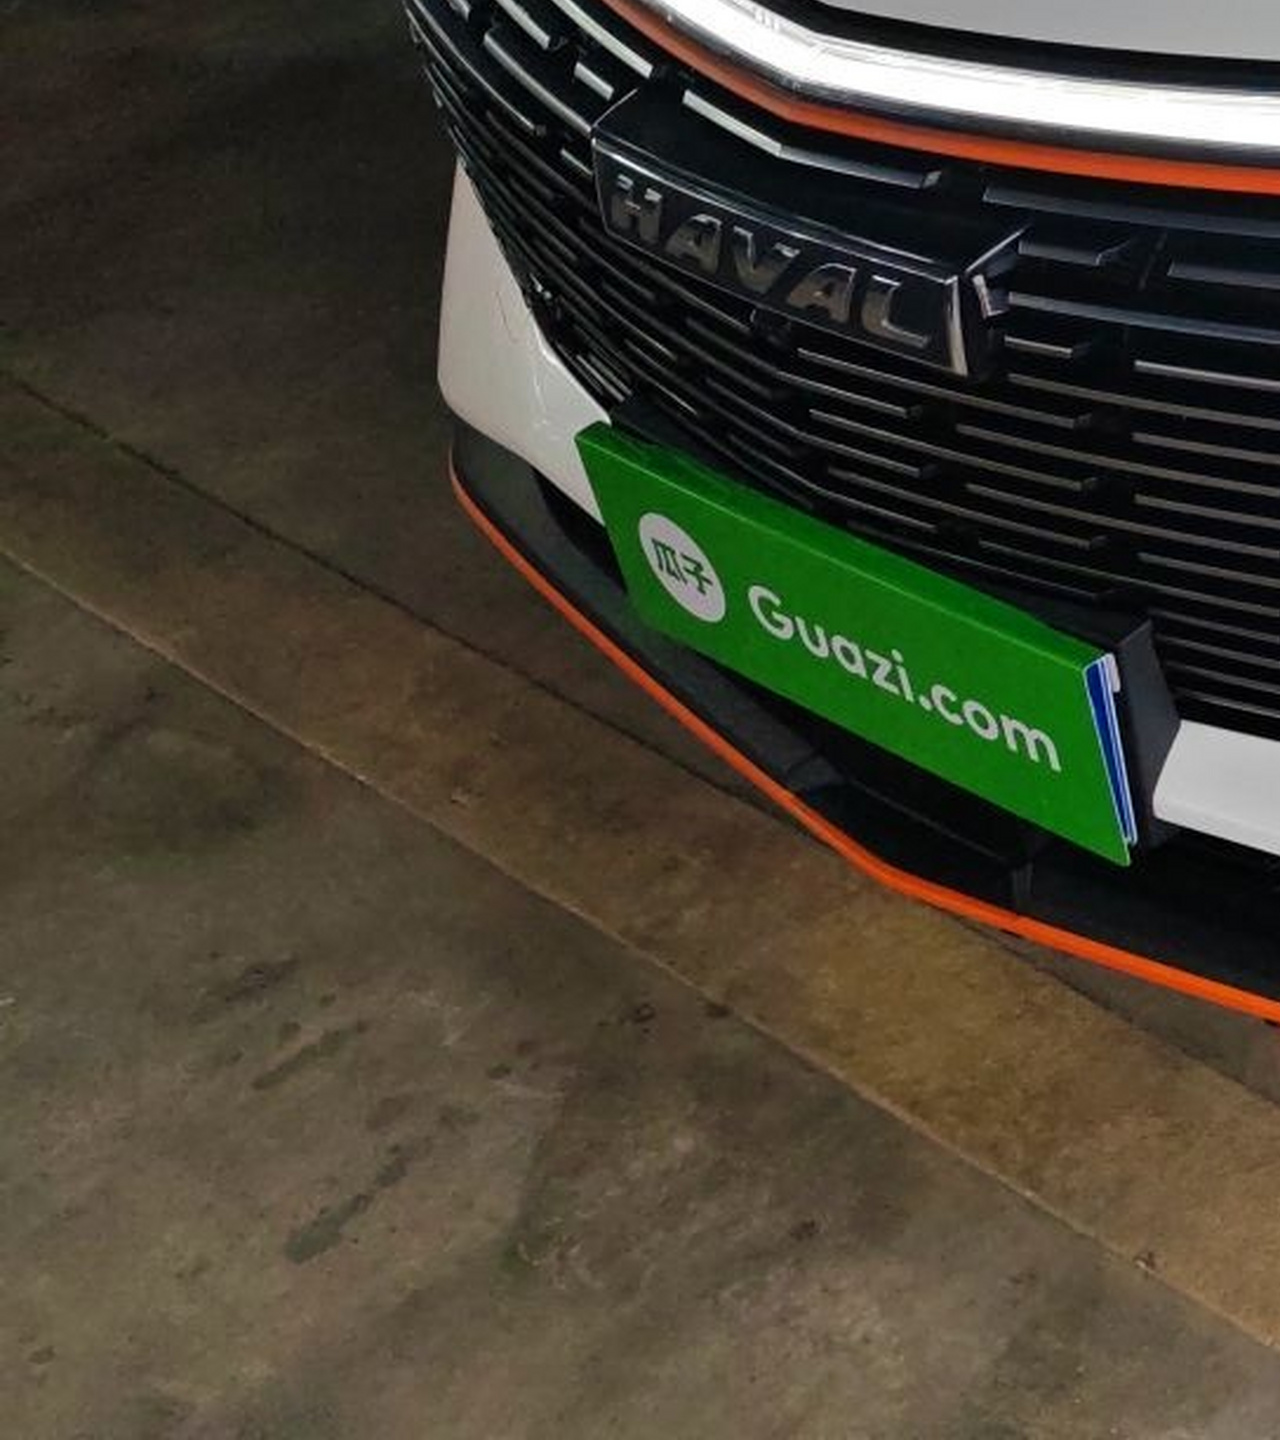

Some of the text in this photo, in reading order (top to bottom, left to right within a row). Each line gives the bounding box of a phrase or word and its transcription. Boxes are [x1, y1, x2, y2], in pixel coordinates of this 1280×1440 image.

[610, 172, 930, 350] HAVAL
[650, 537, 1062, 773] 瓜子 Guazi.com
